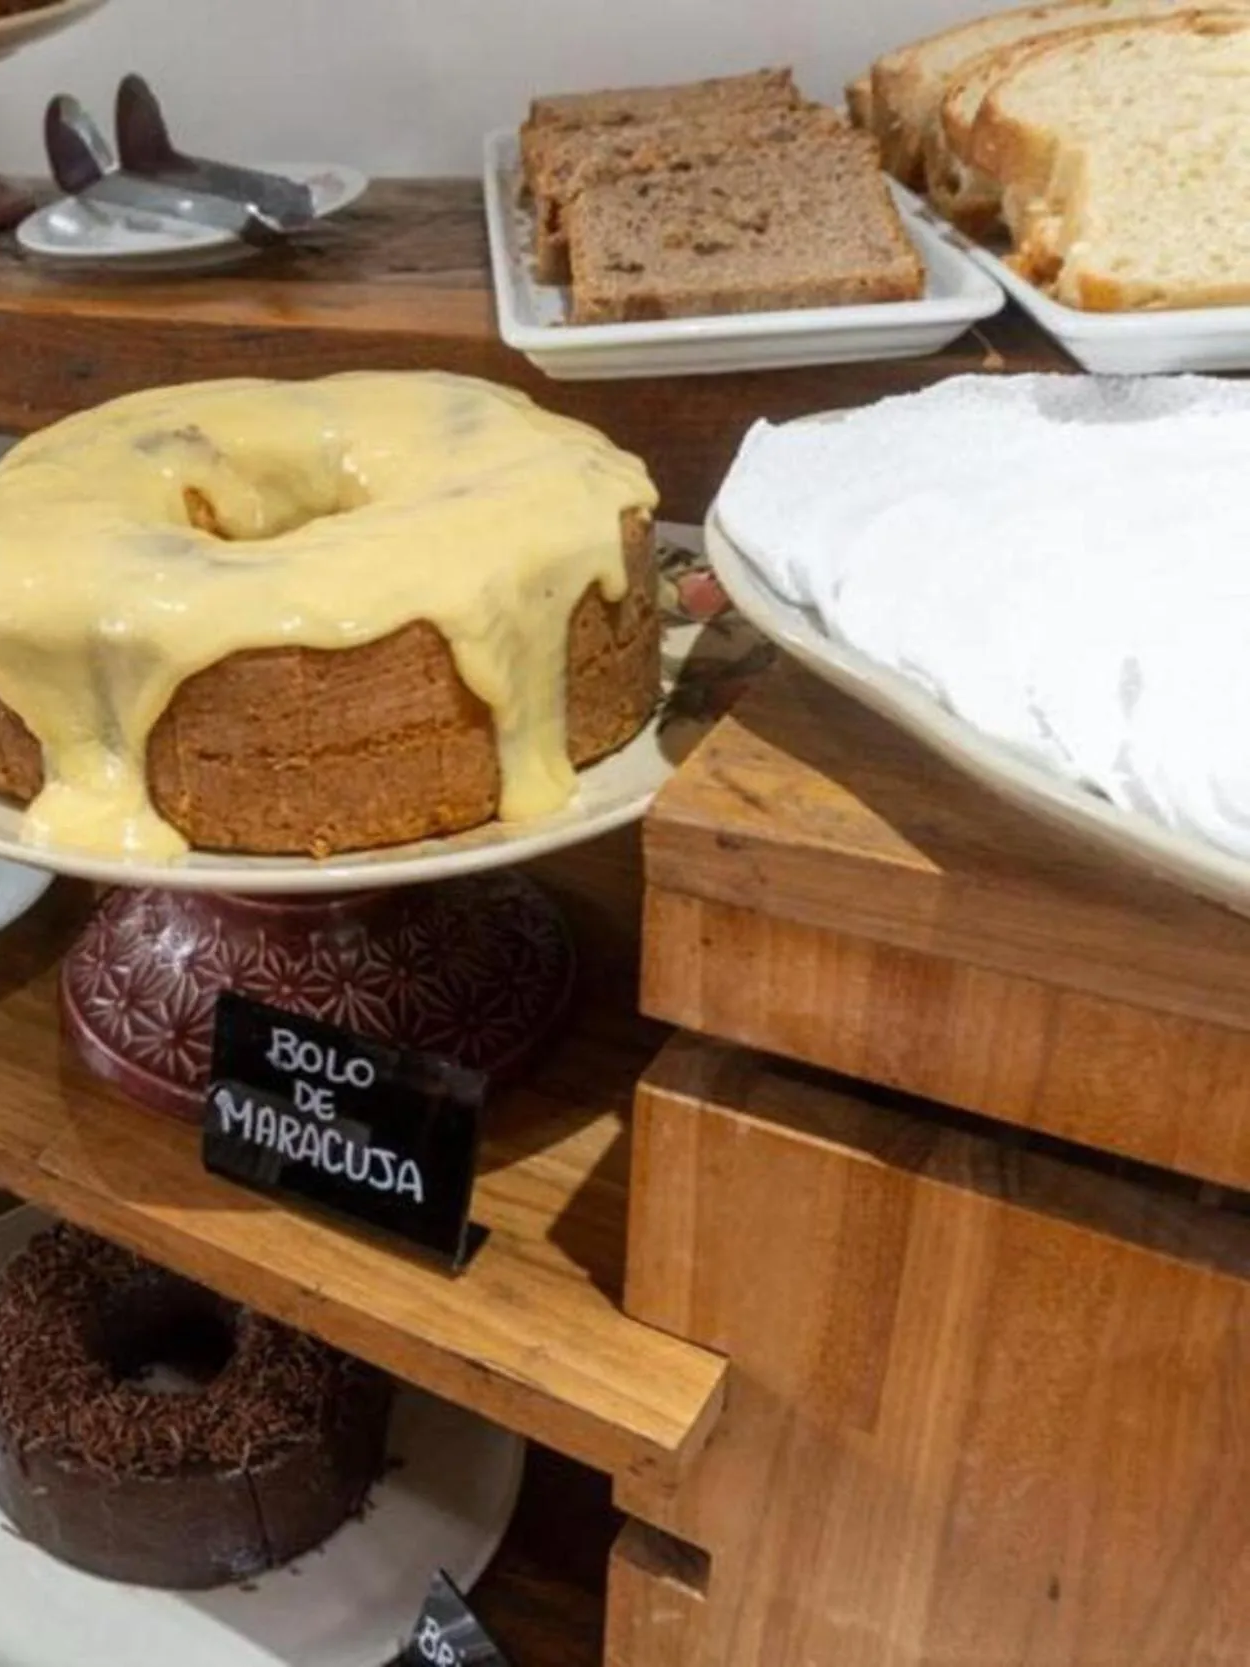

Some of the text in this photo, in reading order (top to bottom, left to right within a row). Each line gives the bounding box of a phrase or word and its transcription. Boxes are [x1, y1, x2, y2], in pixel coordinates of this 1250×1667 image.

[266, 1026, 376, 1089] BOLO
[293, 1079, 336, 1121] DE
[213, 1088, 425, 1204] MARACUJA
